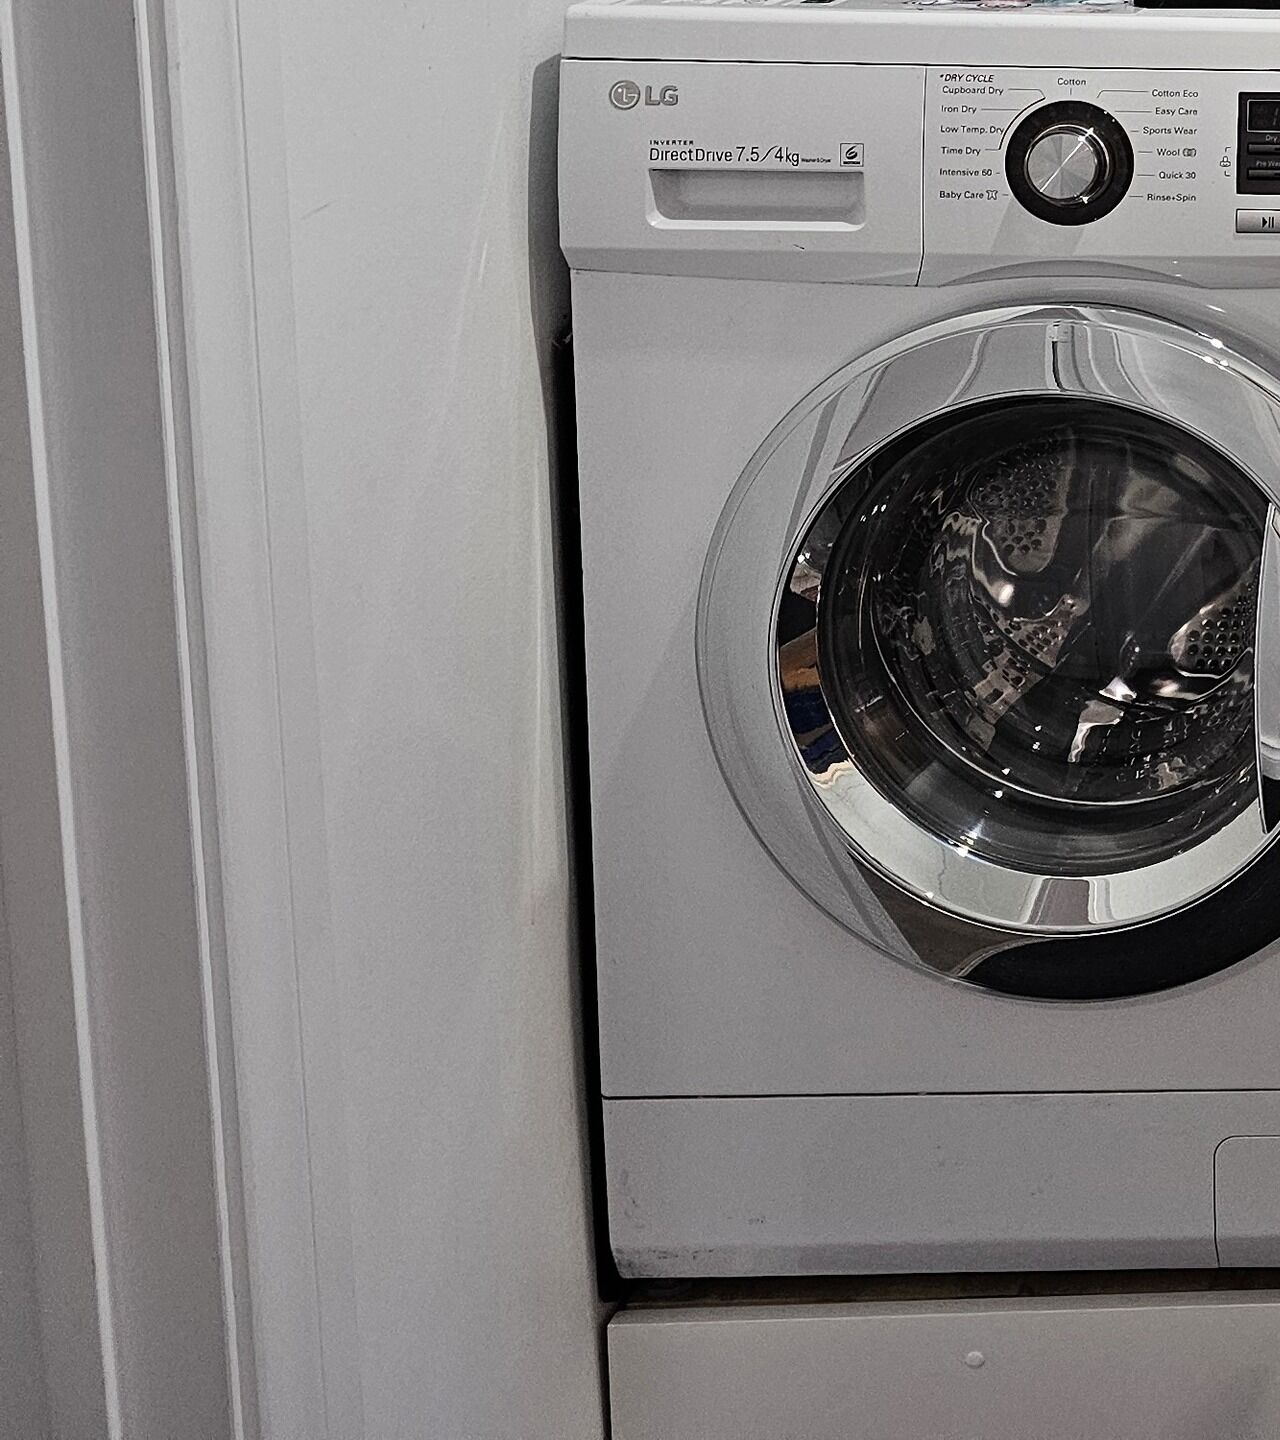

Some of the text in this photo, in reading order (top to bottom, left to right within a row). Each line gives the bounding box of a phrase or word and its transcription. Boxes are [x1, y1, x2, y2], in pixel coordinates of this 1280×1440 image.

[965, 75, 994, 83] CYCLE
[1057, 77, 1086, 86] Cotton
[942, 86, 1004, 95] Cupboard Dry
[1152, 89, 1199, 98] Cotton Eco
[644, 85, 679, 106] LG
[961, 106, 977, 115] Dry
[1155, 108, 1175, 117] Easy
[961, 126, 987, 136] Temp.
[989, 126, 1004, 135] Dry
[1143, 127, 1197, 136] Sports Wear
[941, 147, 981, 156] Time Dry
[1156, 148, 1180, 156] Wool
[940, 168, 993, 176] Intensive 60
[1159, 171, 1184, 180] Quick
[939, 191, 984, 200] Baby Care
[1147, 194, 1197, 203] Rinse+Spin
